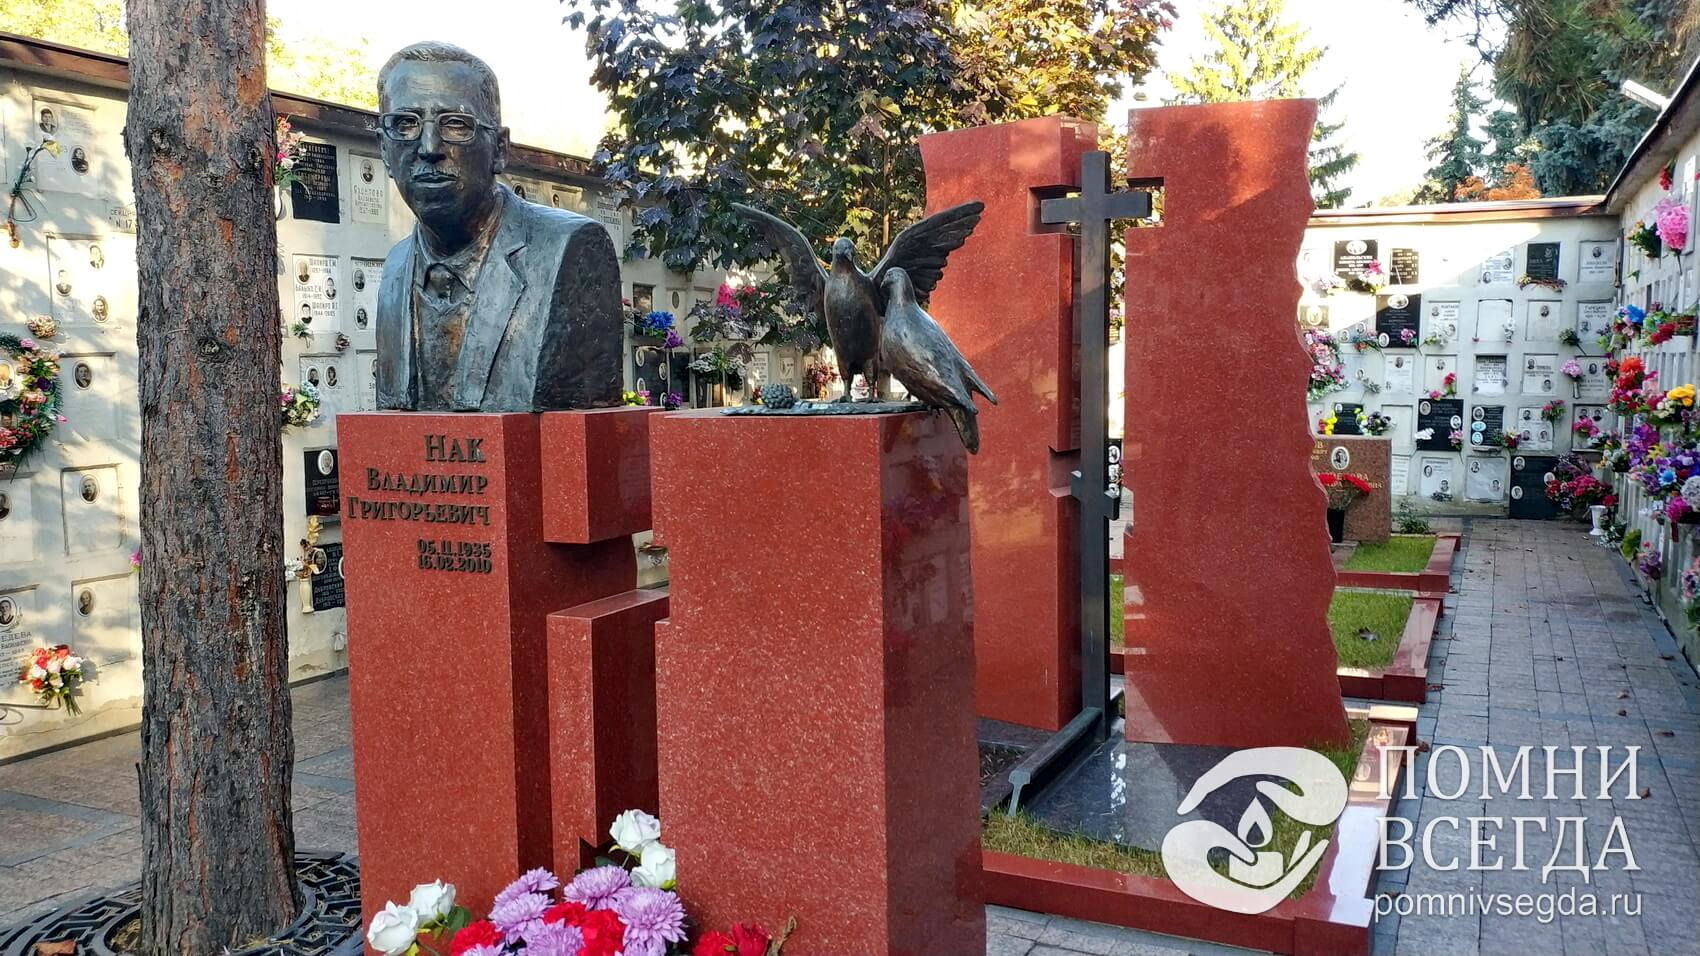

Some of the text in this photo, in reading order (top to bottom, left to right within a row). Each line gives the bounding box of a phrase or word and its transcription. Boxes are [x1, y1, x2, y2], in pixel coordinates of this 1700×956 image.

[424, 434, 486, 463] НАК
[366, 467, 488, 496] ВЛАДИМИР
[346, 496, 491, 525] ГРИГОРЬЕВИЧ
[417, 539, 492, 558] 05.11.1935
[418, 554, 492, 573] 16.02.2010
